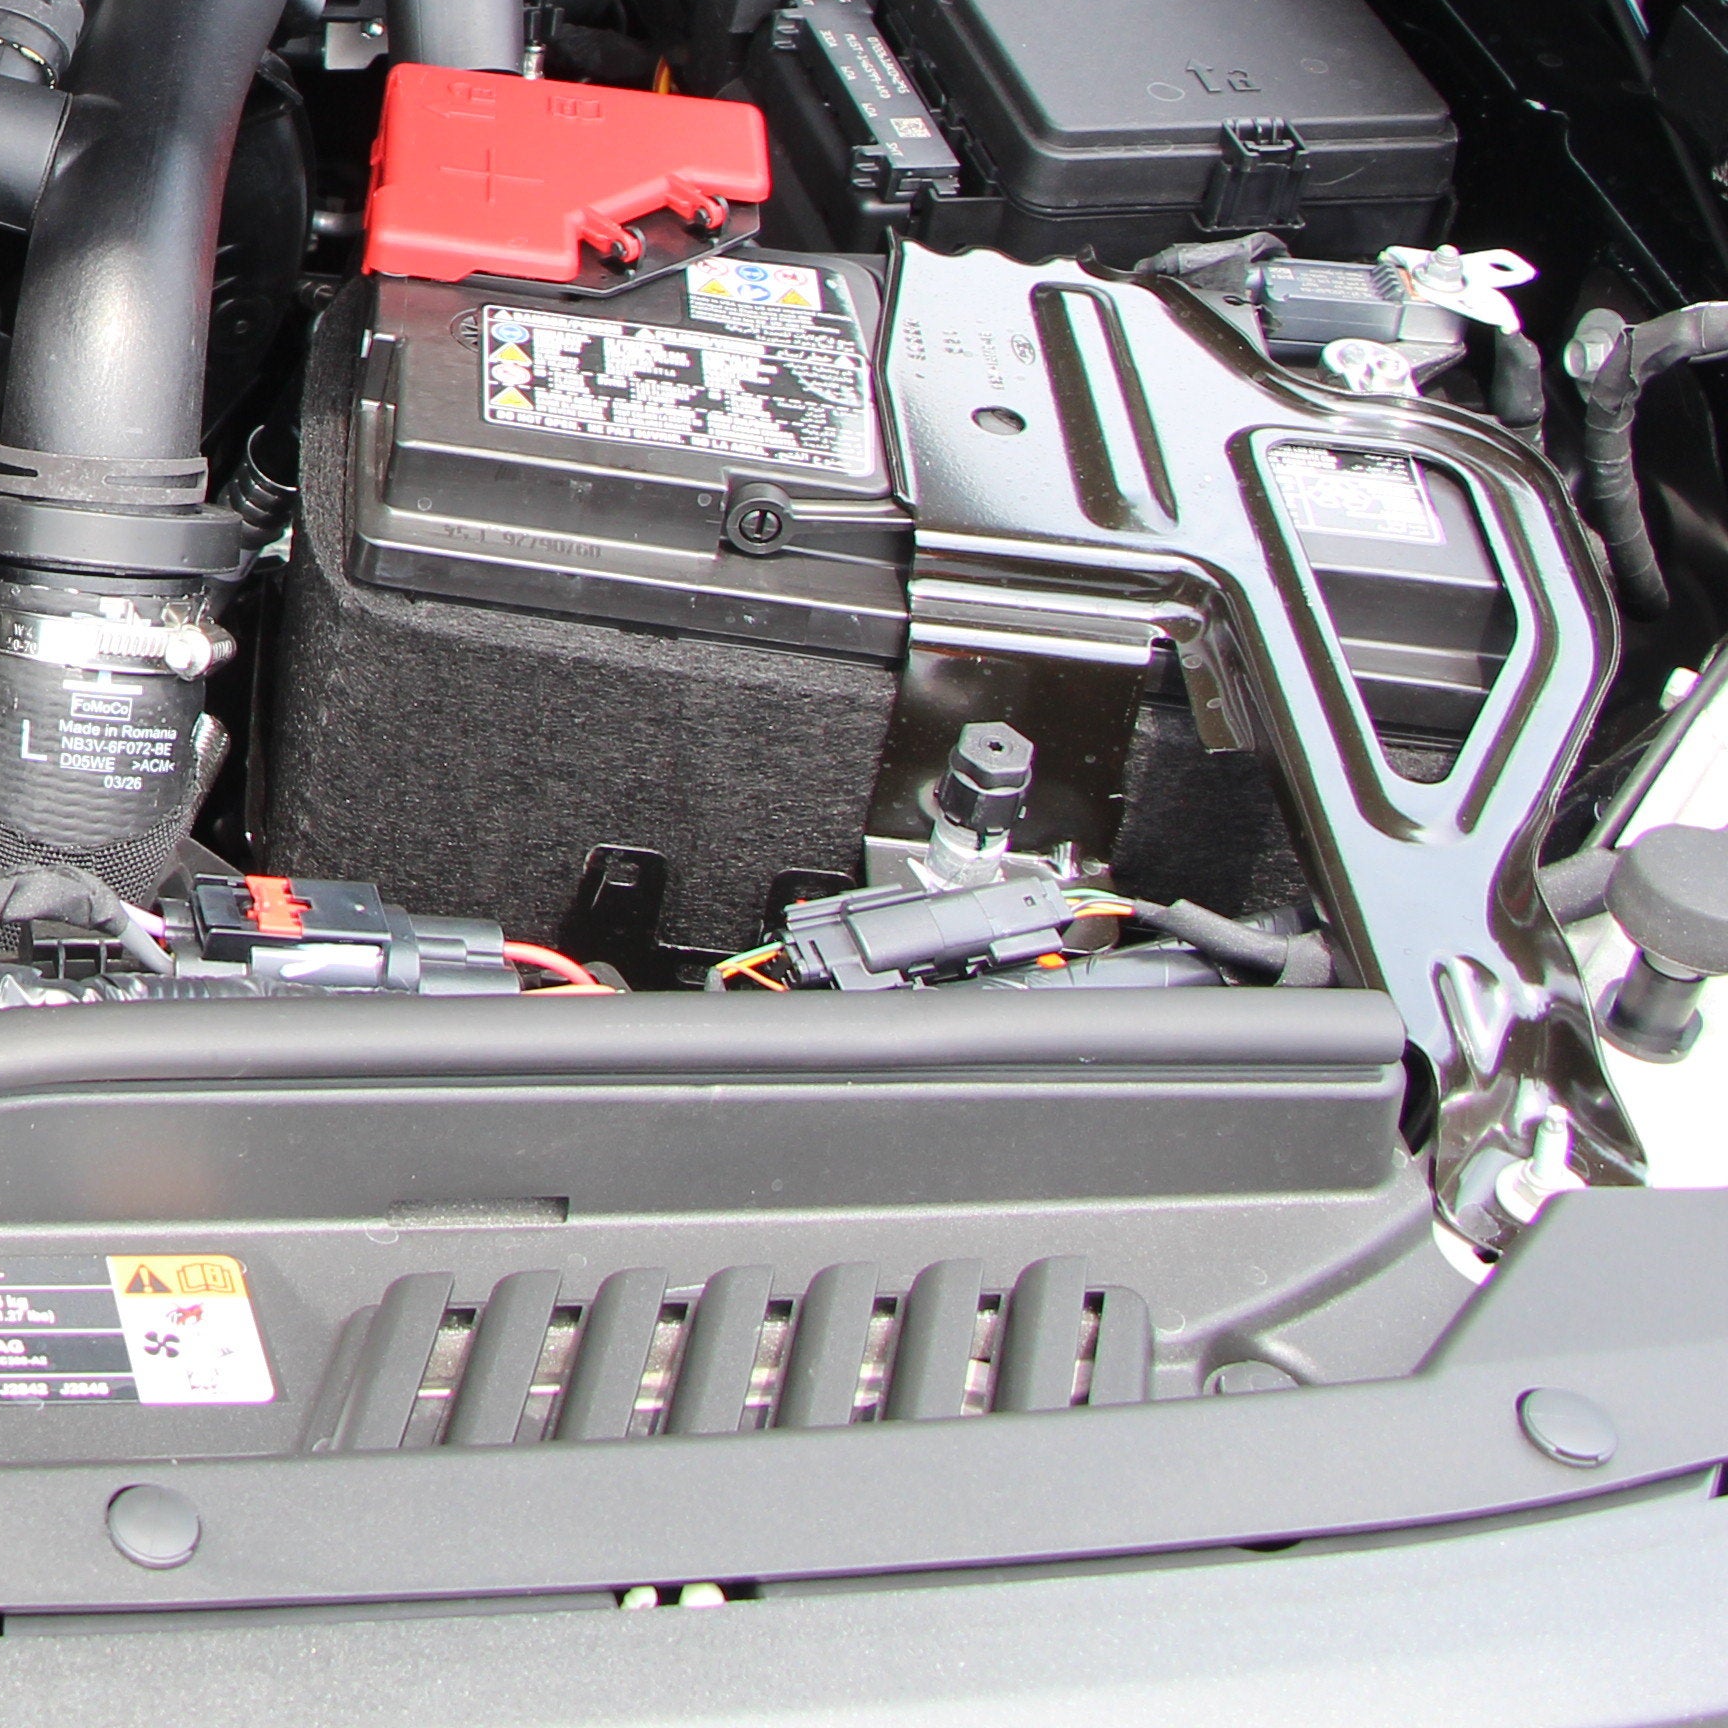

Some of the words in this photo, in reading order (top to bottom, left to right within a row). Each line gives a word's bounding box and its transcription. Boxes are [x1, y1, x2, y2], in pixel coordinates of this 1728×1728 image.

[497, 409, 515, 421] DO
[517, 412, 542, 425] NOT
[73, 698, 129, 715] FoMoCo
[59, 719, 101, 736] Made
[105, 724, 118, 737] in
[121, 724, 178, 740] Romania
[21, 719, 48, 761] L
[104, 775, 142, 790] 03/26
[6, 1294, 29, 1311] kg
